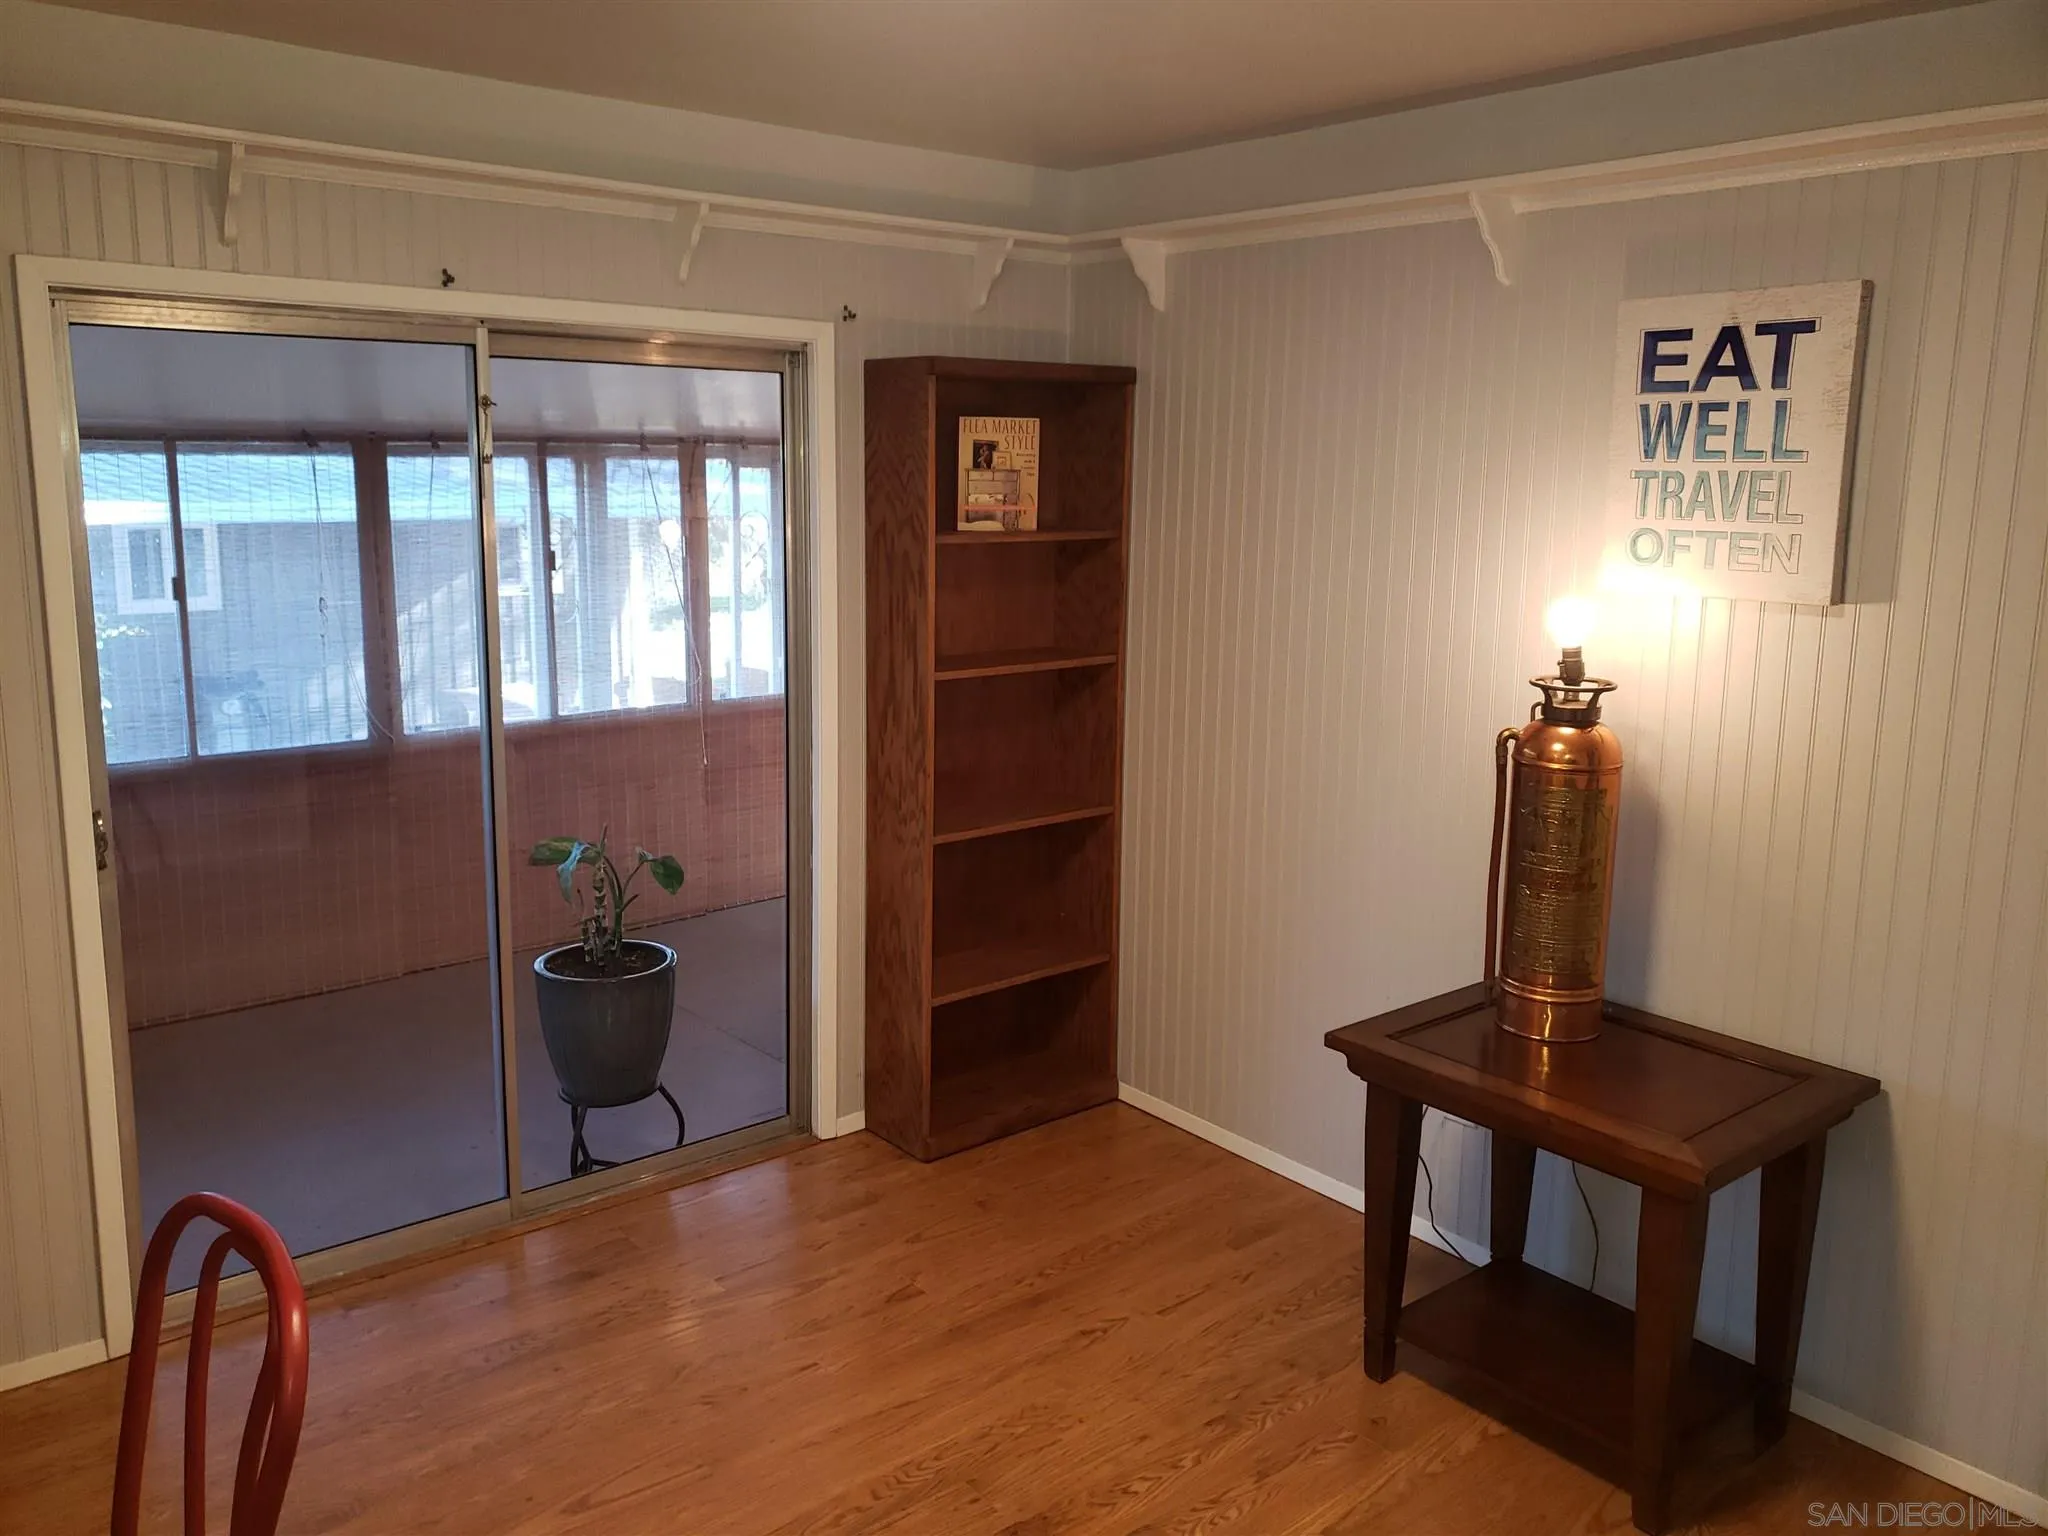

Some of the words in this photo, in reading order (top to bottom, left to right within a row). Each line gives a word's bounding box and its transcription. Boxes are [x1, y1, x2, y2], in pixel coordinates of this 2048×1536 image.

[1636, 317, 1821, 394] EAT
[963, 418, 988, 434] FLEA
[992, 419, 1037, 435] MARKET
[1004, 435, 1035, 450] STYLE
[1635, 398, 1809, 462] WELL
[1630, 470, 1803, 524] TRAVEL
[1628, 528, 1802, 574] OFTEN
